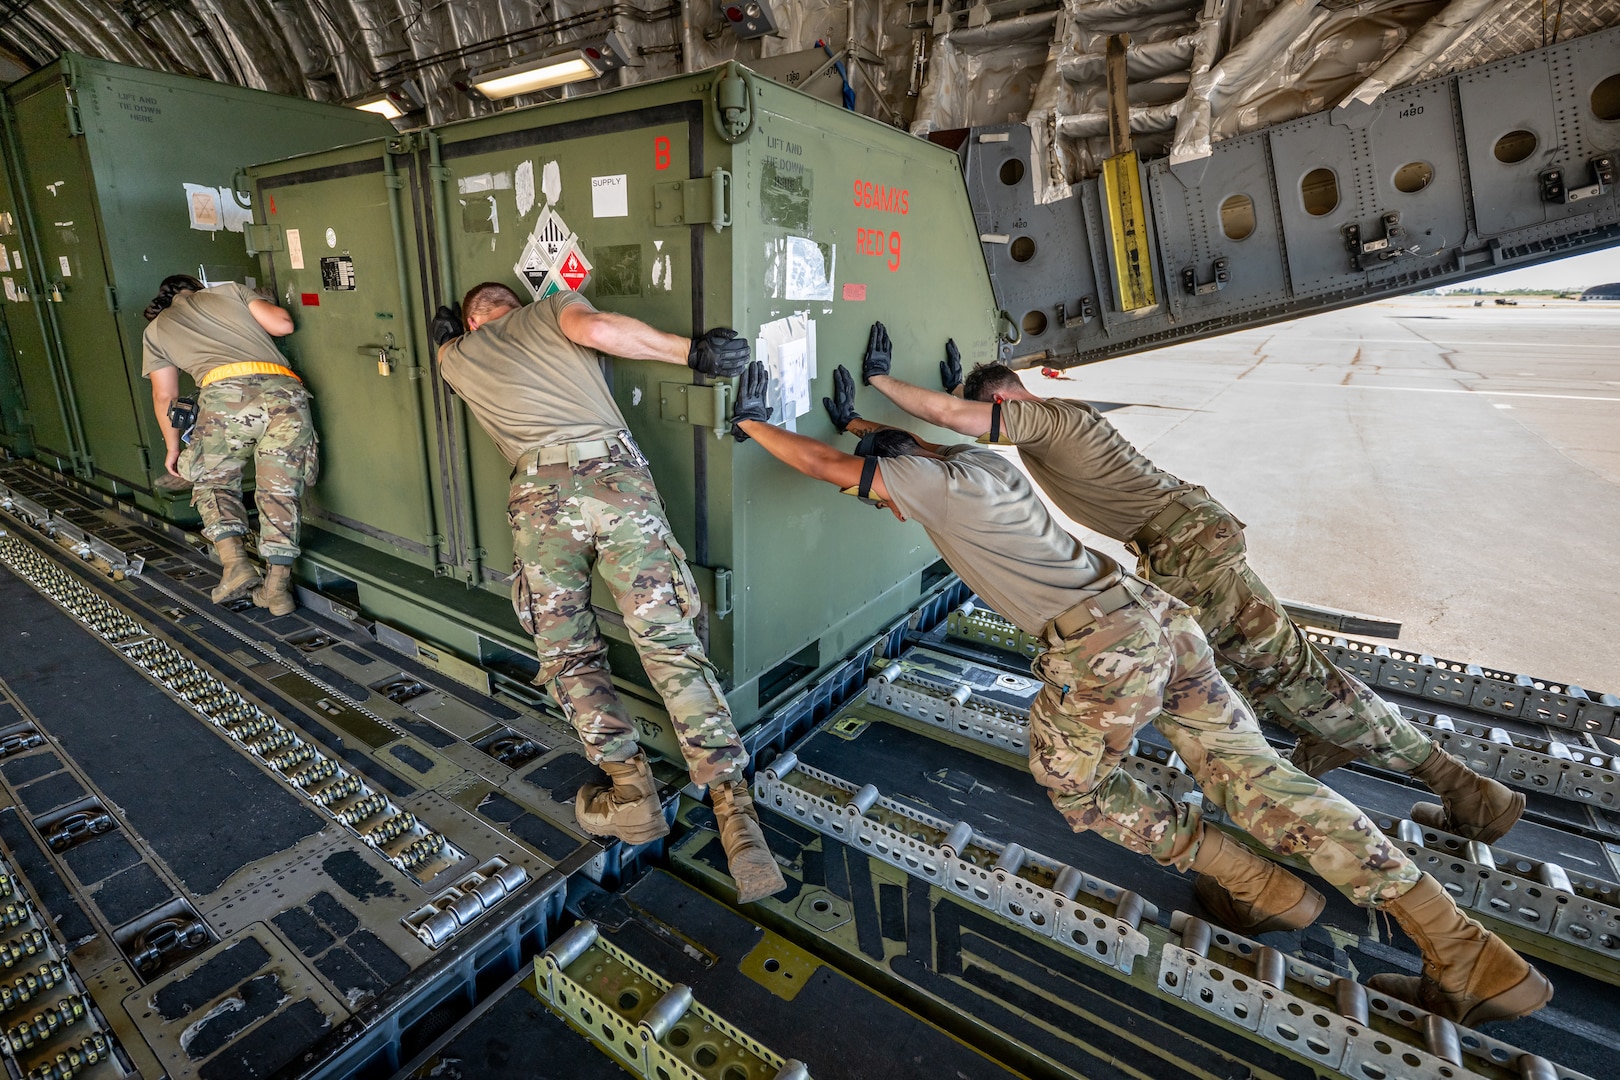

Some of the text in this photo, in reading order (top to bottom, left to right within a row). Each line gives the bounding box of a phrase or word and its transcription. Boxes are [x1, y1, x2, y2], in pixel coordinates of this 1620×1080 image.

[786, 72, 800, 82] 1360
[117, 92, 158, 105] LIFT AND
[133, 104, 161, 115] DOWN
[1399, 106, 1424, 119] 1480
[130, 113, 153, 123] HERE
[767, 135, 803, 156] LIFT AND
[654, 135, 671, 171] B
[779, 158, 805, 174] DOWN
[592, 177, 621, 187] SUPPLY
[853, 179, 909, 215] 96AMXS
[269, 194, 277, 215] A
[1012, 221, 1028, 229] 1420
[856, 227, 902, 273] RED 9
